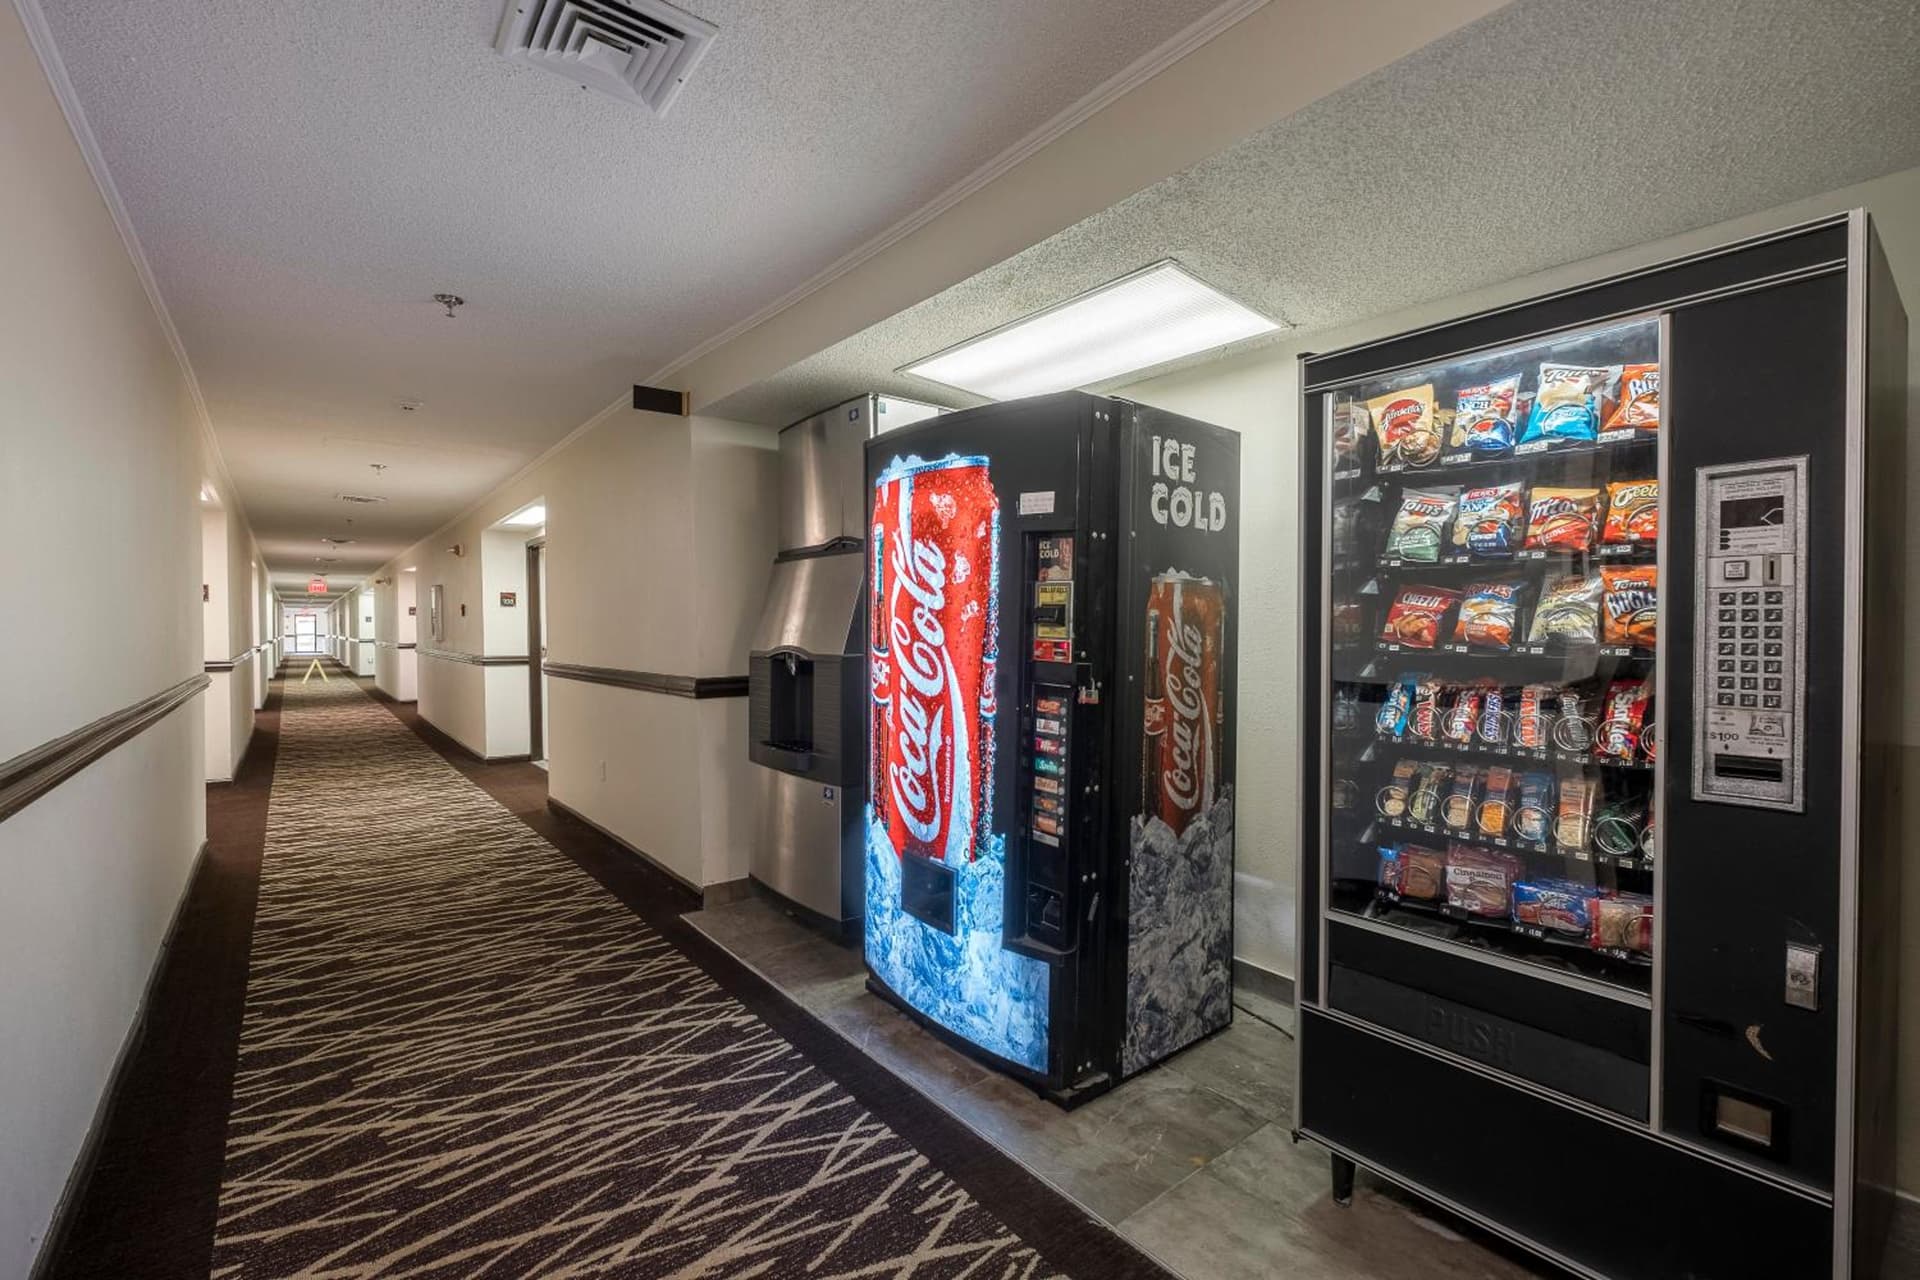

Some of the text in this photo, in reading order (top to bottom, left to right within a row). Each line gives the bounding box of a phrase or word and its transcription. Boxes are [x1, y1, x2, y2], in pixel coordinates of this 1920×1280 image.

[1152, 435, 1196, 483] ICE
[1151, 482, 1226, 533] COLD
[1040, 549, 1060, 559] COLD
[889, 527, 946, 842] Coca-Cola
[1164, 616, 1203, 811] Coca-Cola
